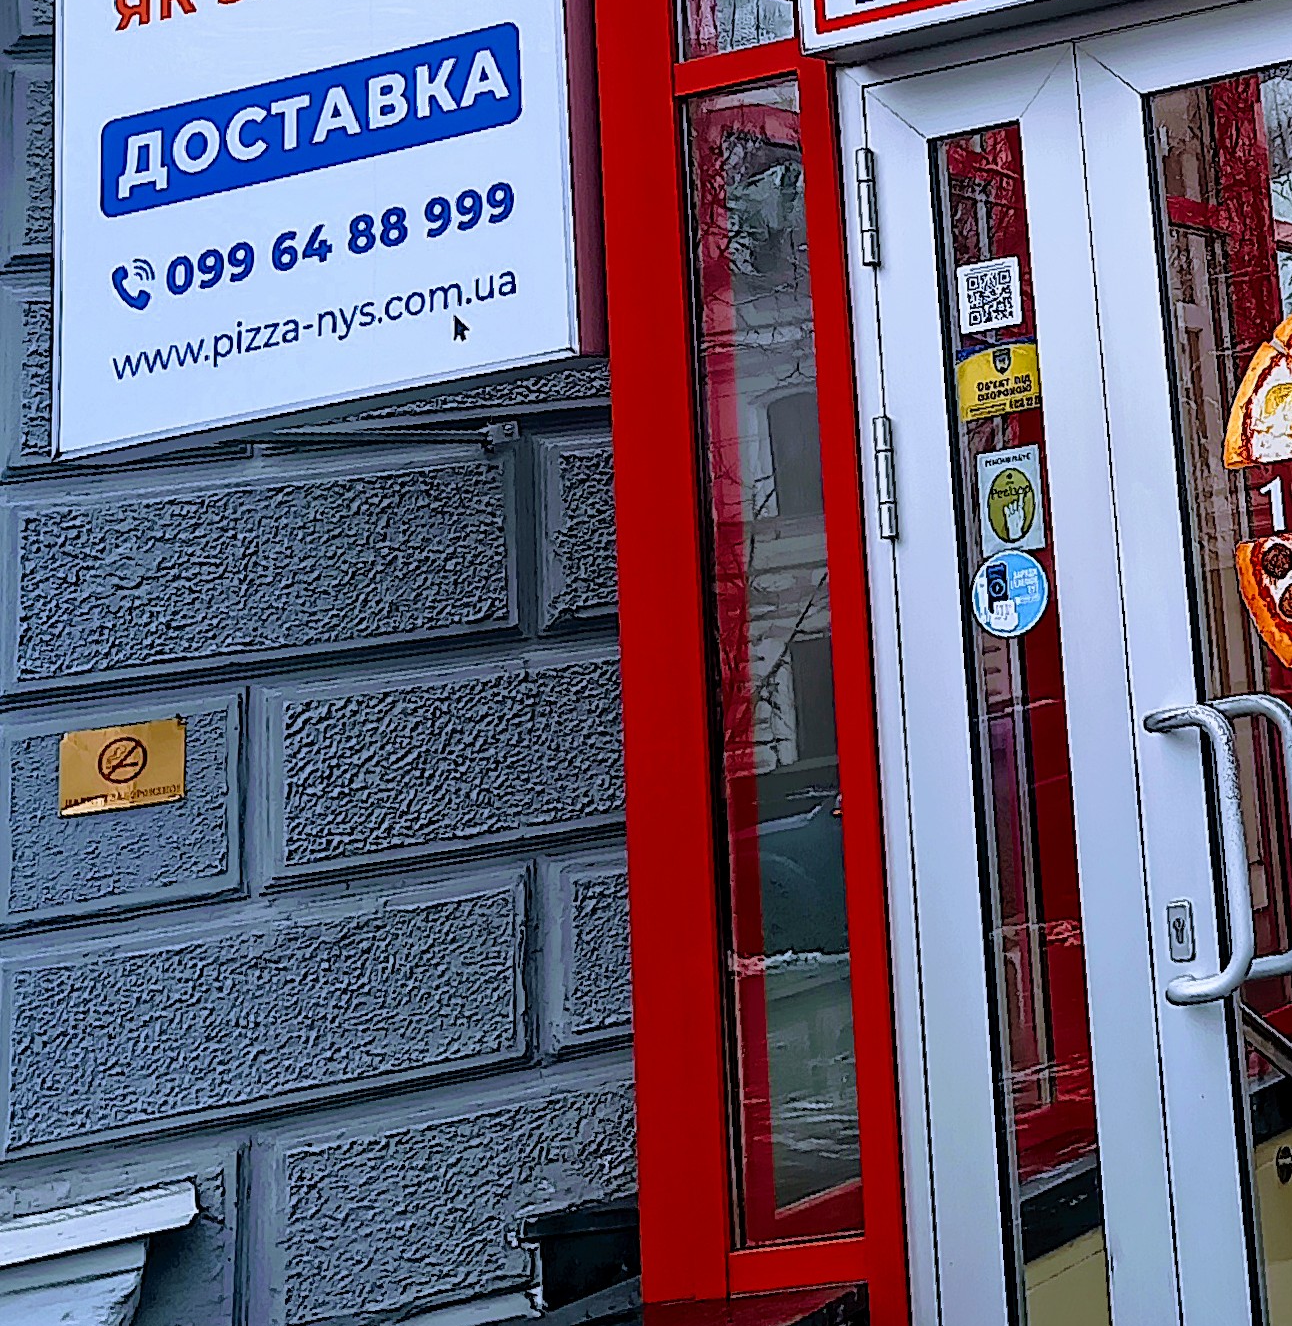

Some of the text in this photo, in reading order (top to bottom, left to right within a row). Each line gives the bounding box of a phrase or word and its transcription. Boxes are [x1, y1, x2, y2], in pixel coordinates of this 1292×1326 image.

[117, 48, 510, 198] ДОСТАВКА
[165, 181, 516, 296] 099 64 88 999
[112, 267, 517, 380] www.pizza-nys.com.ua
